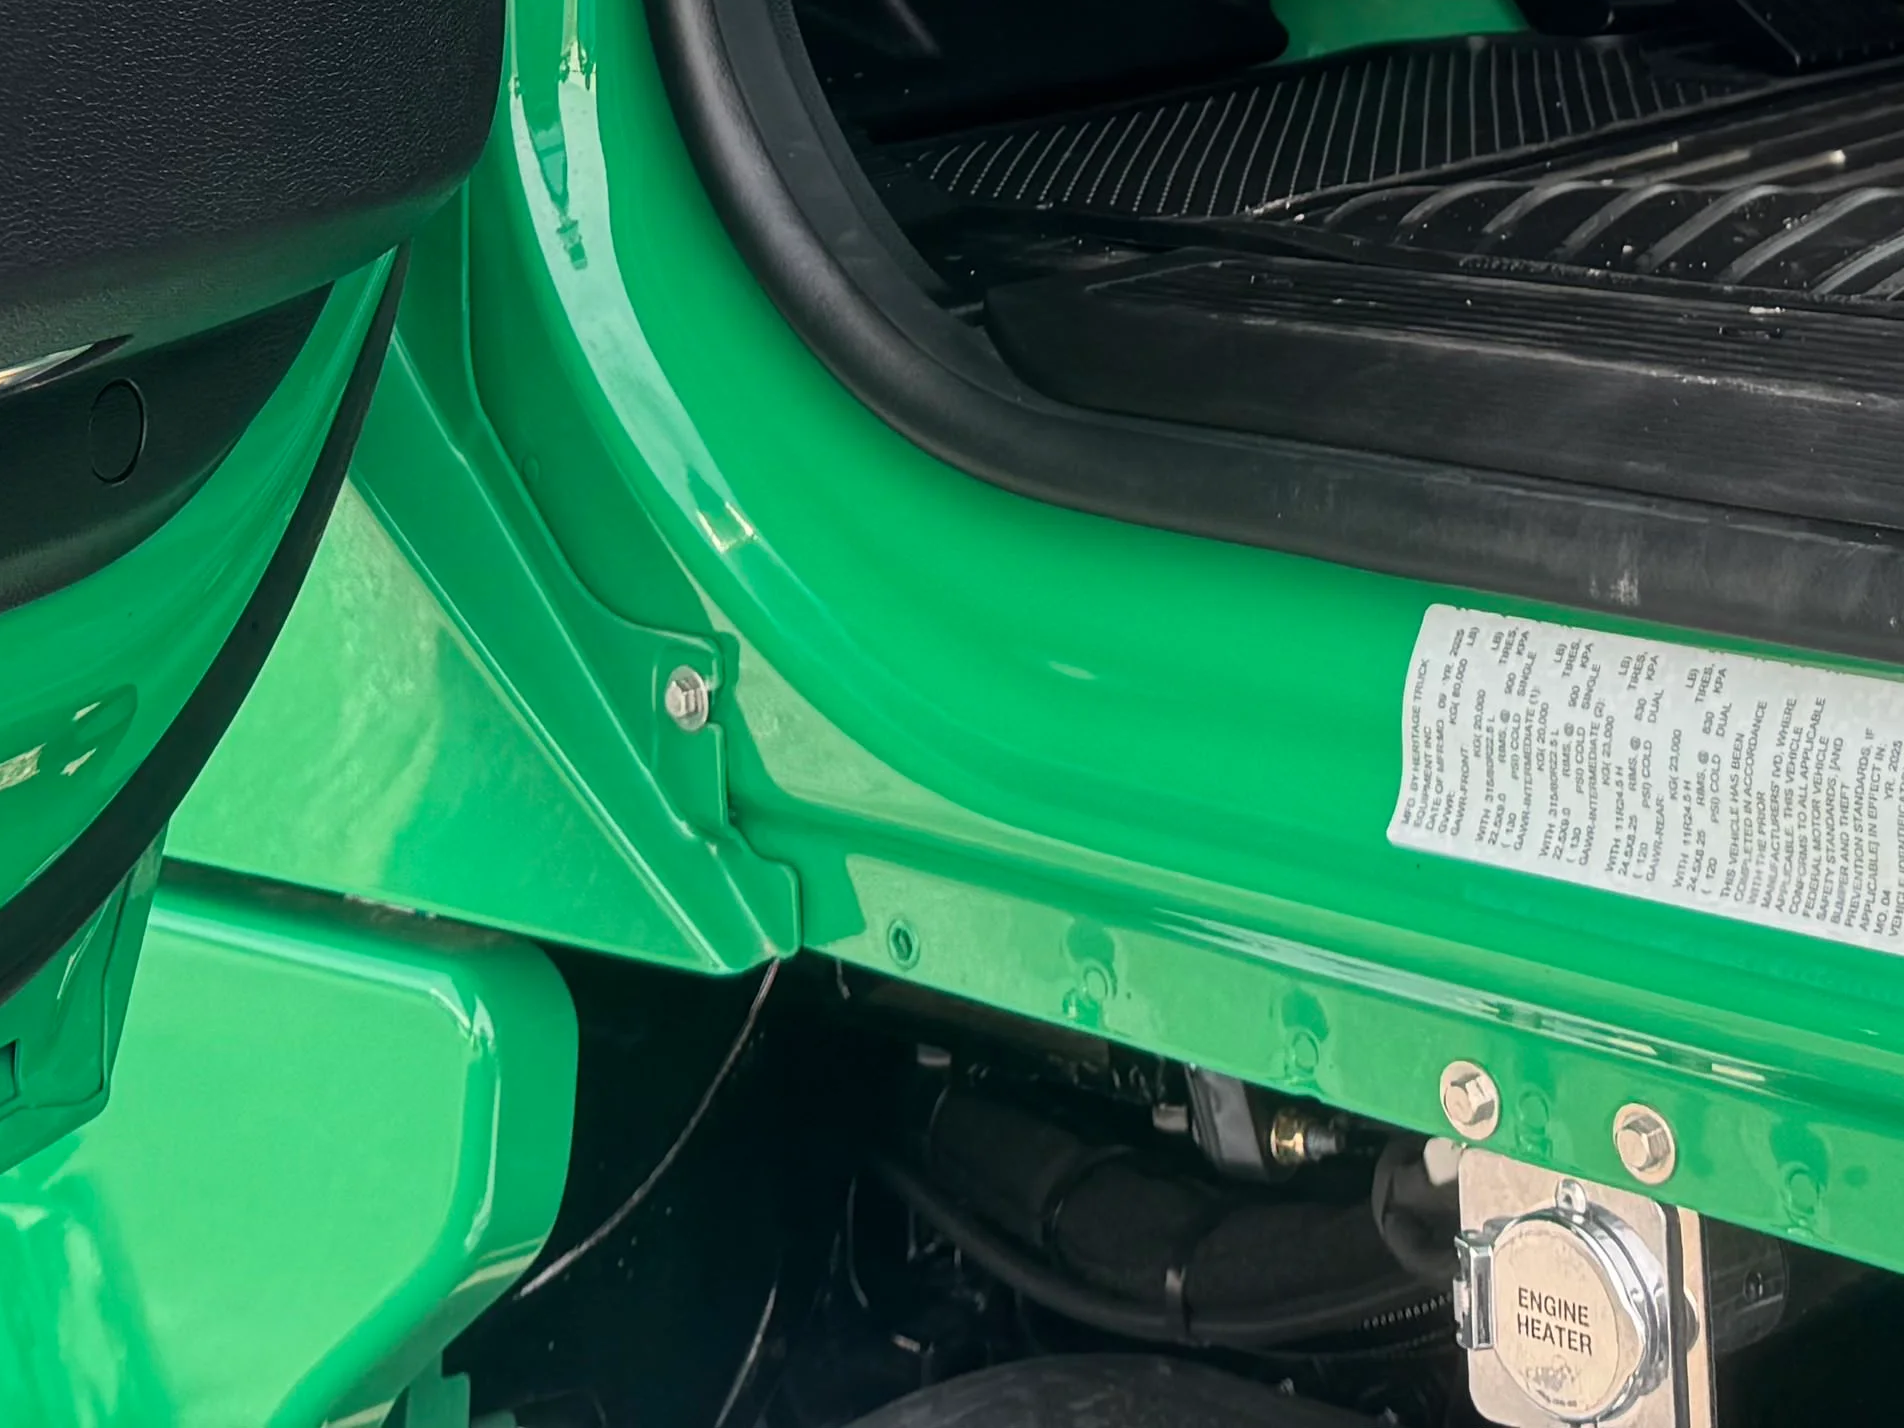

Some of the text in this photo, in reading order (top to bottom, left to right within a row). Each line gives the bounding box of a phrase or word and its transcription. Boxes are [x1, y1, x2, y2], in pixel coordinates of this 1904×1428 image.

[1515, 630, 1529, 656] KPA
[1413, 659, 1429, 700] TRUCK
[1510, 712, 1521, 750] COLD
[1516, 651, 1536, 696] SINGLE
[1712, 668, 1726, 693] KPA
[1473, 689, 1485, 730] 20,000
[1668, 728, 1681, 771] 23,000
[1685, 668, 1699, 688] LB)
[1776, 698, 1796, 746] WHERE
[1411, 706, 1420, 771] HERITAGE
[1709, 754, 1720, 793] COLD
[1715, 702, 1732, 737] DUAL
[1413, 725, 1432, 827] EQUIPMENT INC
[1783, 727, 1803, 818] THIS VEHICLE
[1867, 763, 1881, 819] EFFECT
[1425, 797, 1441, 830] DATE
[1434, 776, 1443, 794] OF
[1475, 808, 1490, 841] WITH
[1719, 732, 1744, 897] THIS VEHICLE HAS BEEN
[1733, 702, 1766, 901] COMPLETED IN ACCORDANCE
[1788, 698, 1825, 914] CONFORMS TO ALL APPLICABLE
[1802, 736, 1829, 917] FEDERAL MOTOR VEHICLE
[1844, 836, 1863, 927] PREVENTION
[1864, 727, 1874, 740] IF
[1867, 822, 1877, 837] IN
[1672, 852, 1688, 887] WITH
[1746, 791, 1766, 904] WITH THE PRIOR
[1830, 782, 1849, 923] BUMPER AND THEFT
[1816, 867, 1834, 920] SAFETY
[1880, 889, 1890, 906] 04
[1517, 1312, 1592, 1357] HEATER
[1518, 1286, 1589, 1327] ENGINE
